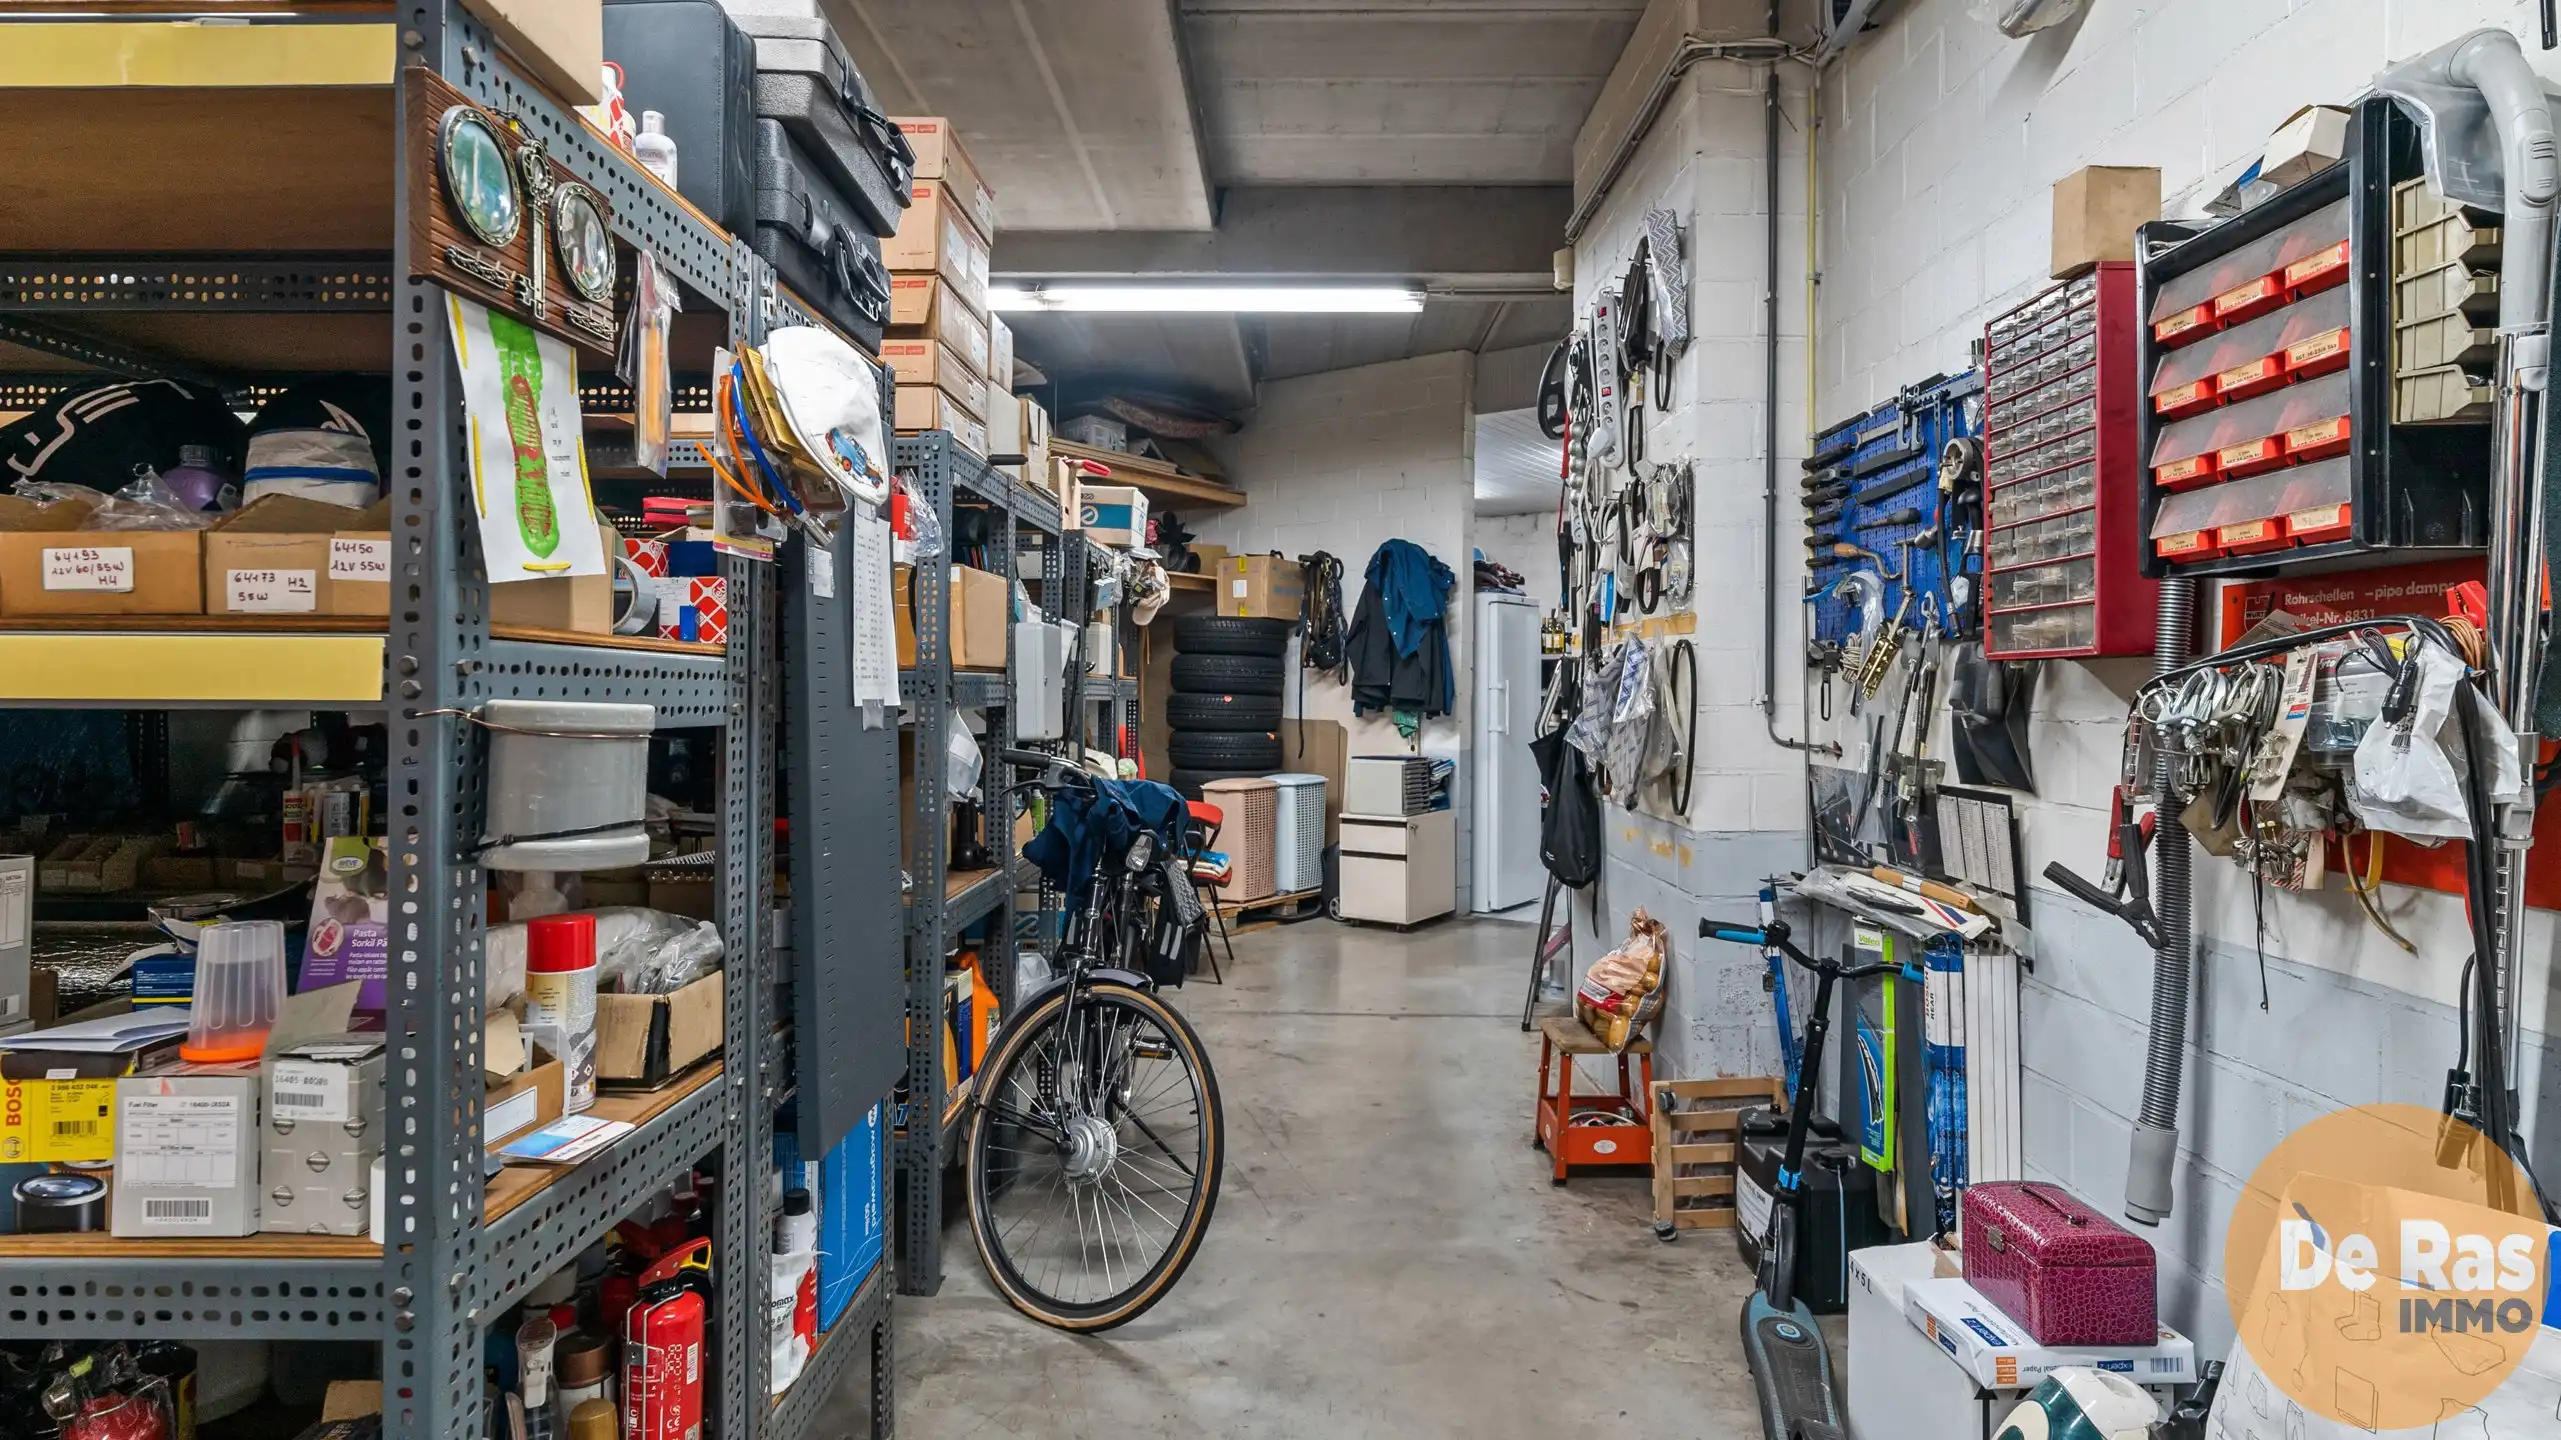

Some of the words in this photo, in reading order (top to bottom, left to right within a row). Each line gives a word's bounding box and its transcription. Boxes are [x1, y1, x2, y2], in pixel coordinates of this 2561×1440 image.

[2284, 591, 2355, 606] Rohrschellen
[353, 929, 376, 938] Pasta
[1858, 934, 1881, 945] Valeo
